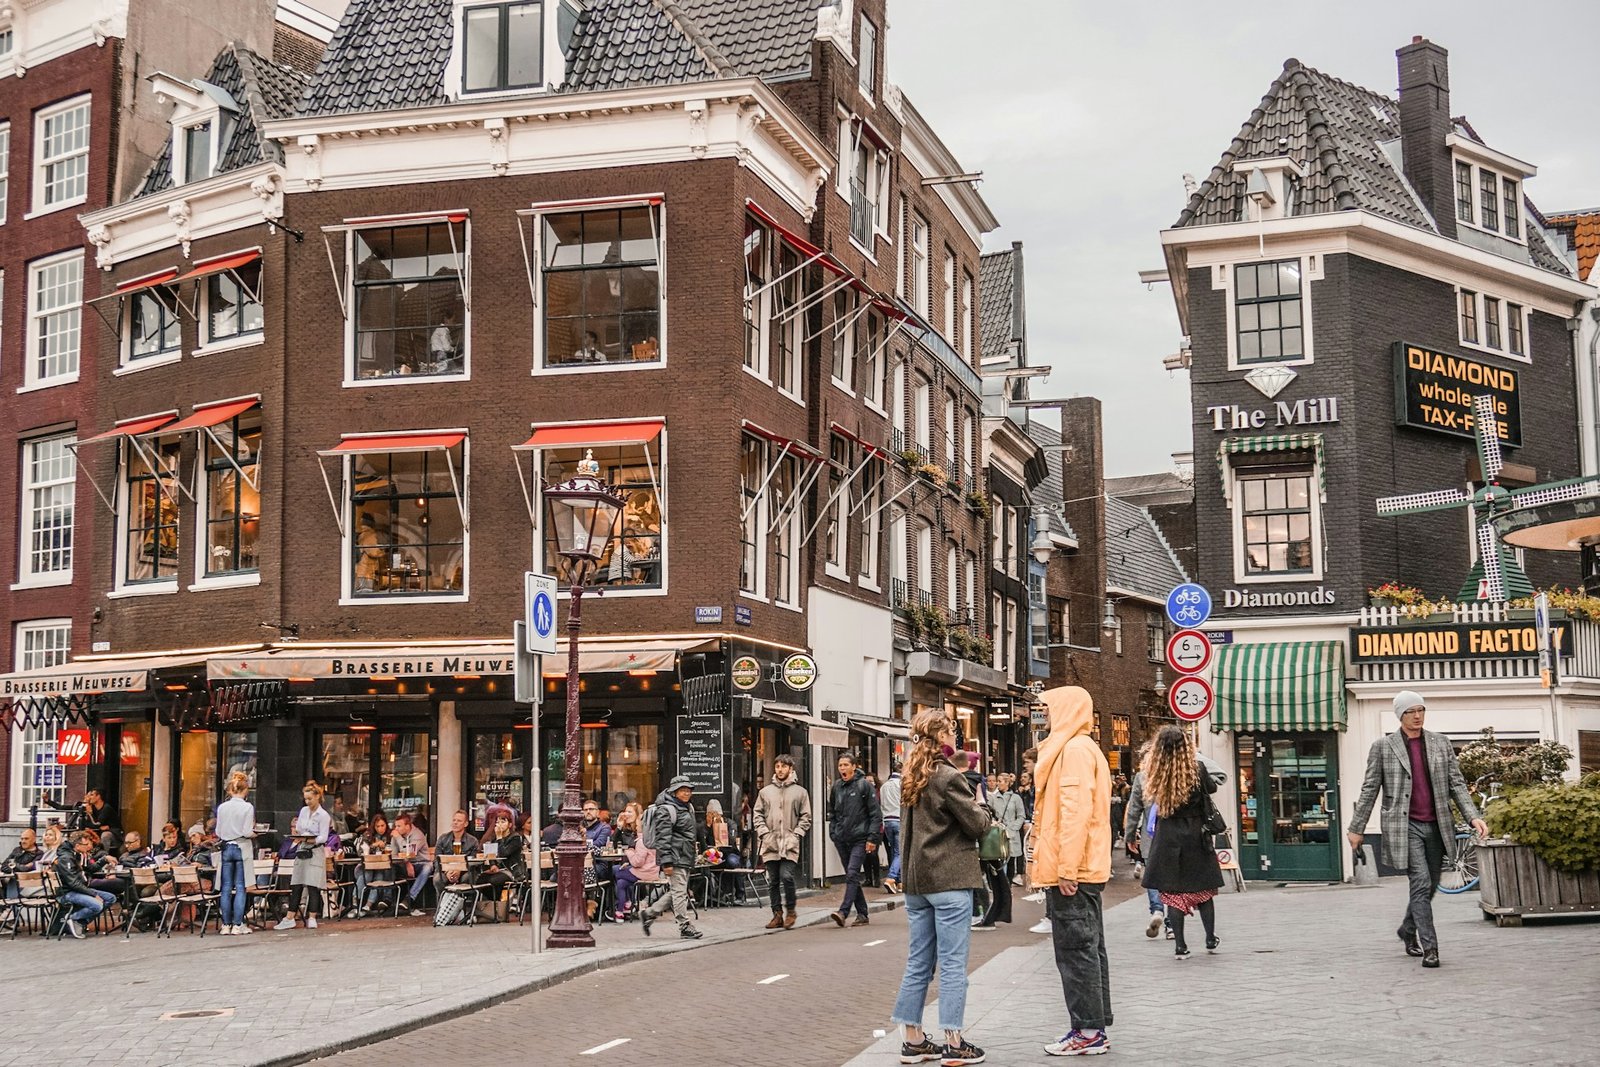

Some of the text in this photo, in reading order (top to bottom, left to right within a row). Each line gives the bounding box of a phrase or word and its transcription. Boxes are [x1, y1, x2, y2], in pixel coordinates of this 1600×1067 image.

[1408, 347, 1515, 392] DIAMOND
[1419, 382, 1508, 415] wholele
[1207, 397, 1340, 431] The Mill
[1420, 404, 1509, 439] TAX-FE
[536, 579, 550, 590] ZONE
[1223, 586, 1336, 608] Diamonds
[699, 608, 719, 616] ROKIN
[1182, 639, 1190, 651] 6
[1358, 627, 1565, 657] DIAMOND FACTOY
[332, 657, 514, 675] BRASSERIE MEUWE
[5, 676, 132, 694] BRASSERIE MEUWESE
[60, 734, 88, 761] illy
